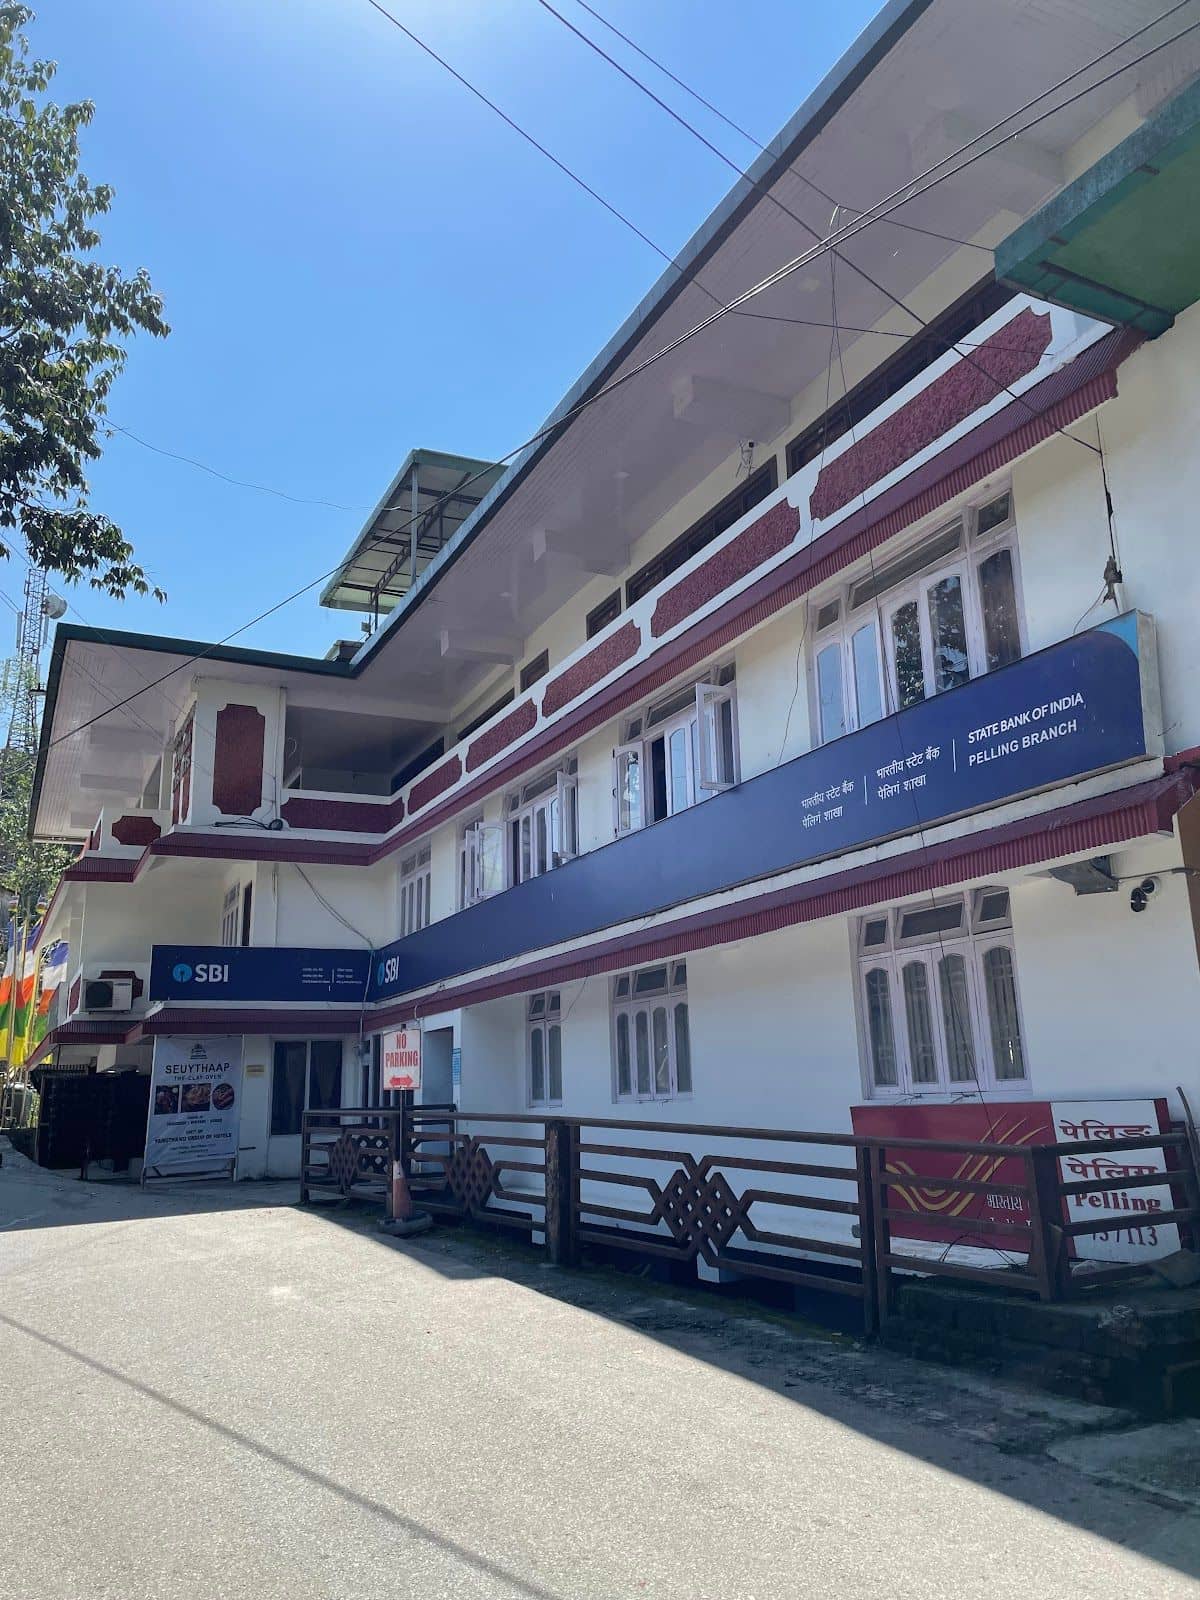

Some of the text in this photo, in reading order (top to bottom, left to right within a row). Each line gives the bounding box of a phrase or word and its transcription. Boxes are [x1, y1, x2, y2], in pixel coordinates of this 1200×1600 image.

[968, 692, 1084, 744] STATE BANK OF INDIA
[969, 719, 1077, 766] PELLING BRANCH
[876, 745, 940, 779] भारतीय स्टेट बैंक
[801, 791, 824, 809] भारतीय
[825, 785, 841, 800] स्टेट
[194, 964, 229, 983] SBI
[384, 955, 400, 984] SBI
[396, 1033, 407, 1050] NO
[165, 1062, 230, 1074] SEUYTHAAP
[385, 1051, 418, 1068] PARKING
[1074, 1191, 1161, 1214] Pelling
